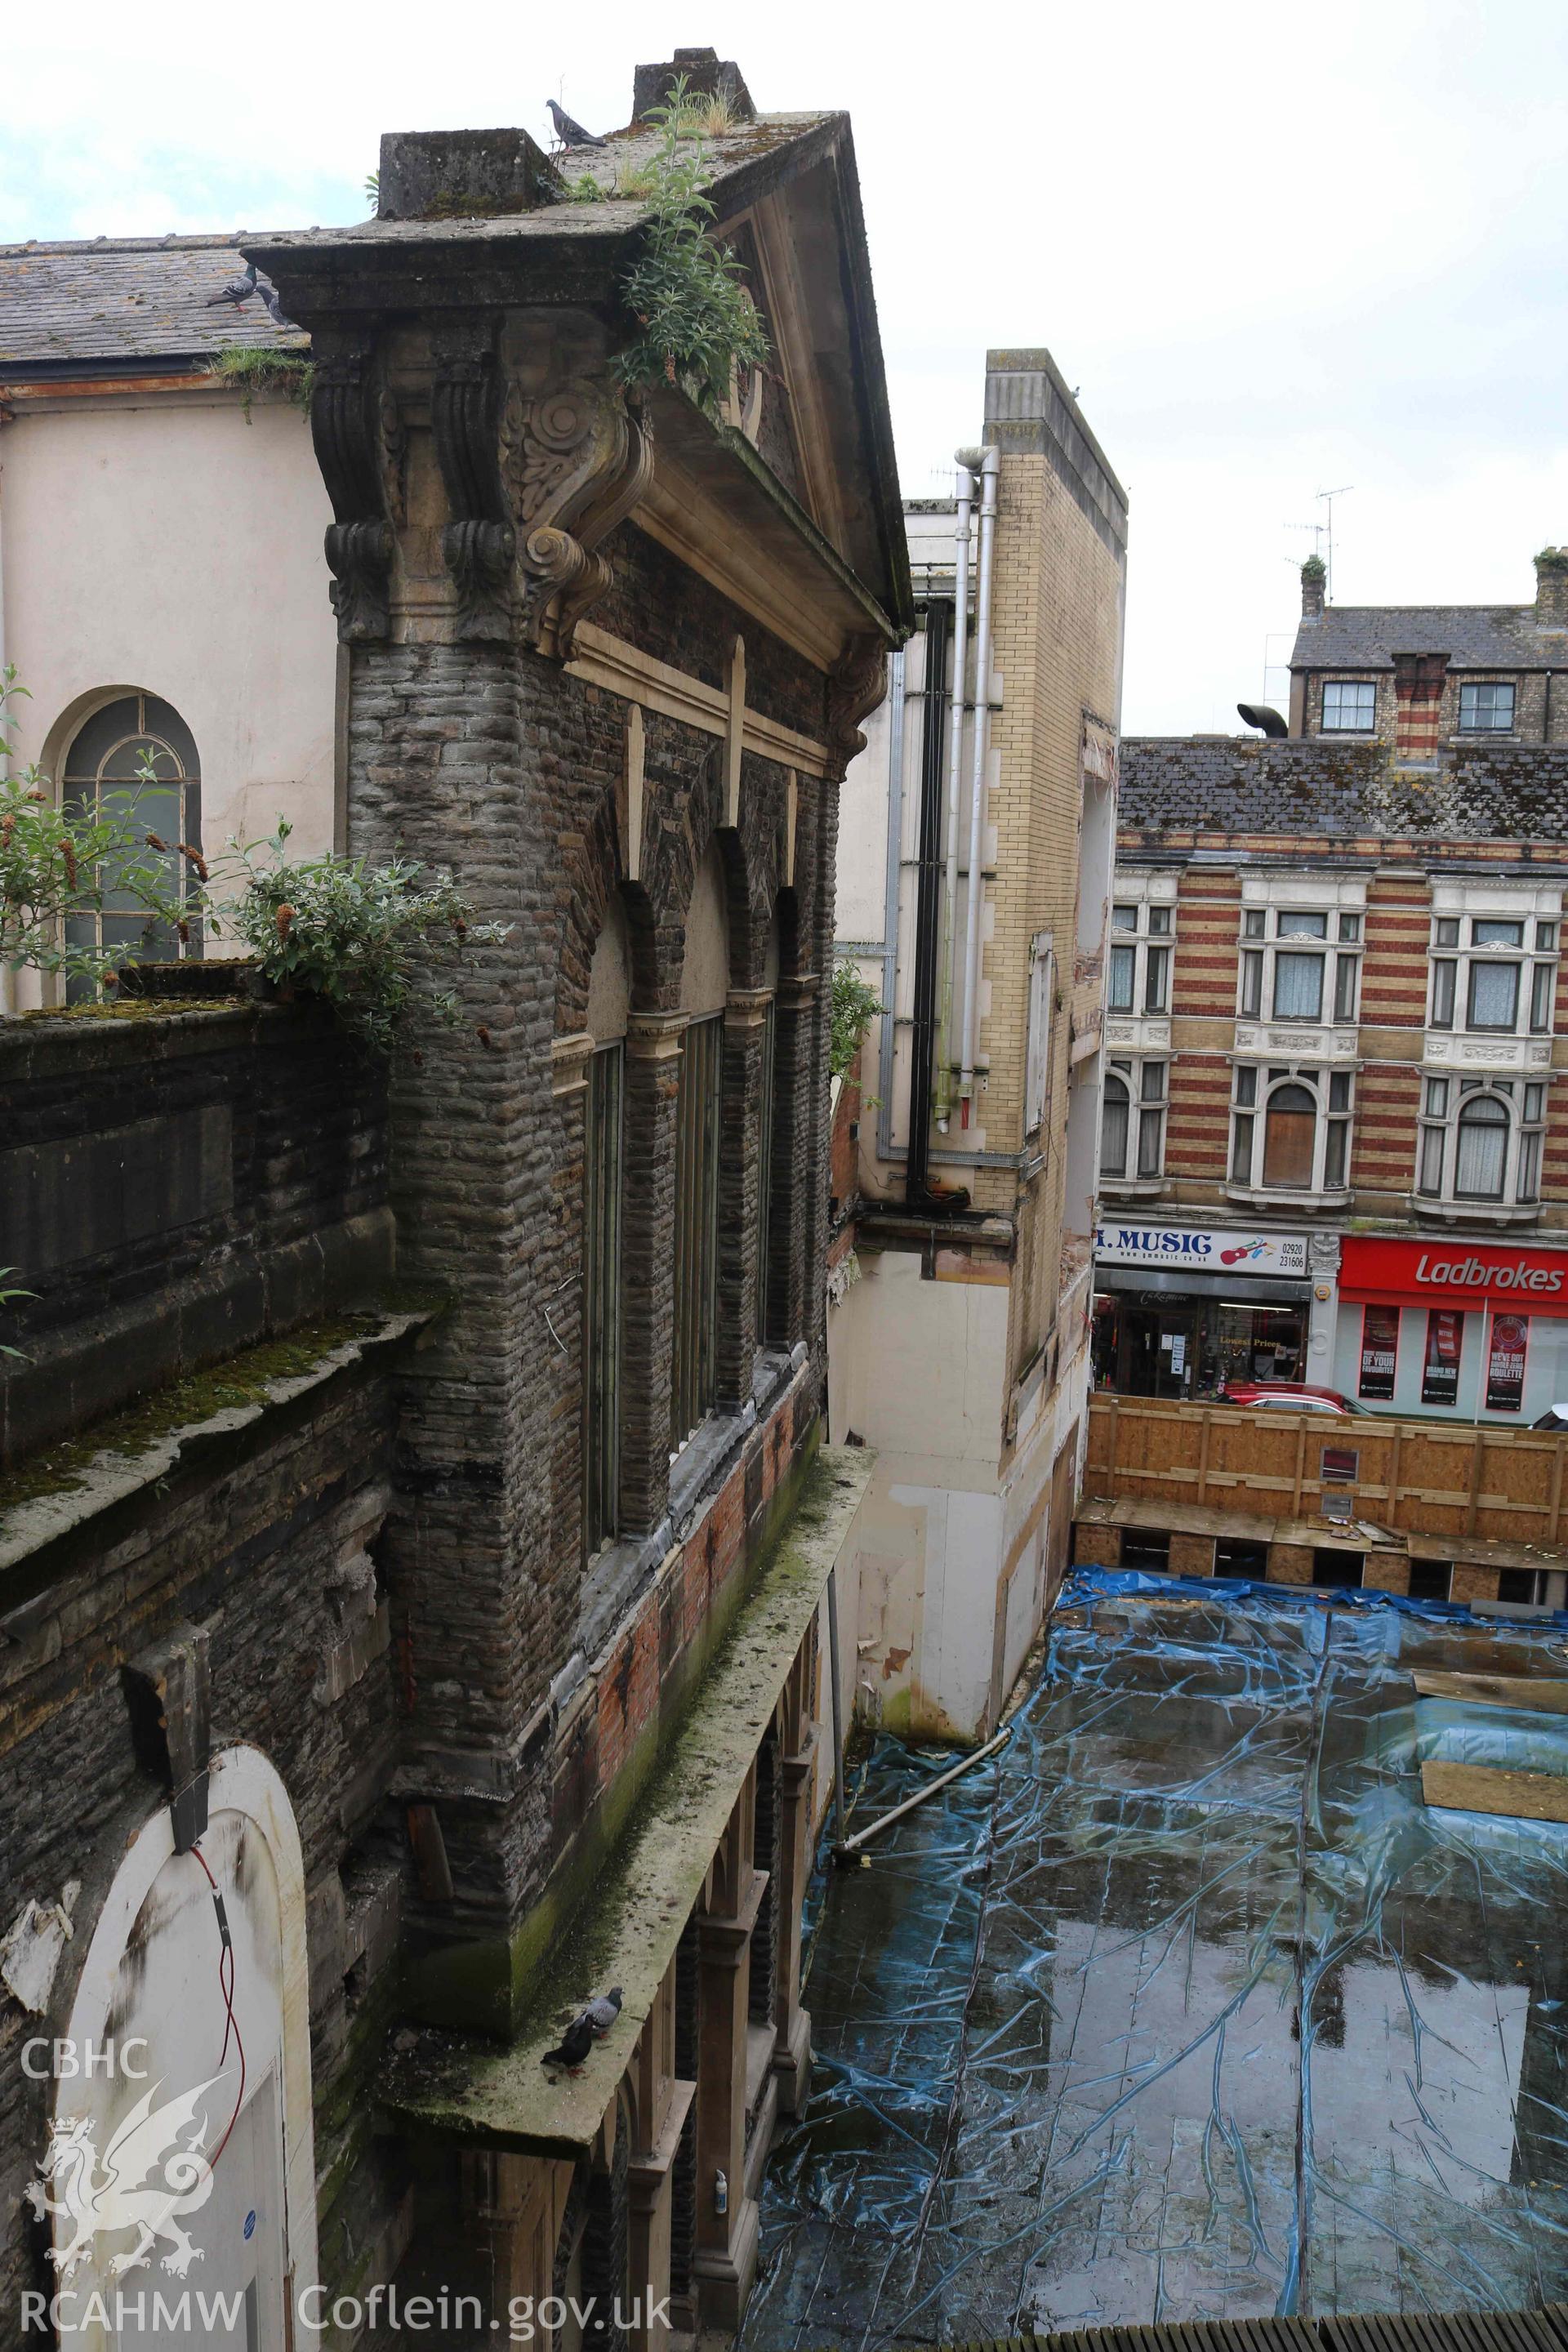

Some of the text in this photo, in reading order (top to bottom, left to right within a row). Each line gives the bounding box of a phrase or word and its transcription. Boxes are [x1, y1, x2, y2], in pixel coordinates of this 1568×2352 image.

[1116, 1230, 1212, 1254] MUSIC
[1282, 1243, 1303, 1254] 02920
[1120, 1251, 1206, 1262] www.gmmusic.co.uk
[1280, 1256, 1303, 1267] 231606
[1415, 1254, 1565, 1291] Ladbrokes
[1220, 1335, 1281, 1348] Lowest Prices
[1362, 1356, 1395, 1367] OF YOUR
[1491, 1352, 1524, 1363] WE'VE GOT
[1361, 1365, 1394, 1374] FAVOURITES
[1427, 1365, 1457, 1375] BRAND NEW
[1490, 1368, 1523, 1379] ROULETTE
